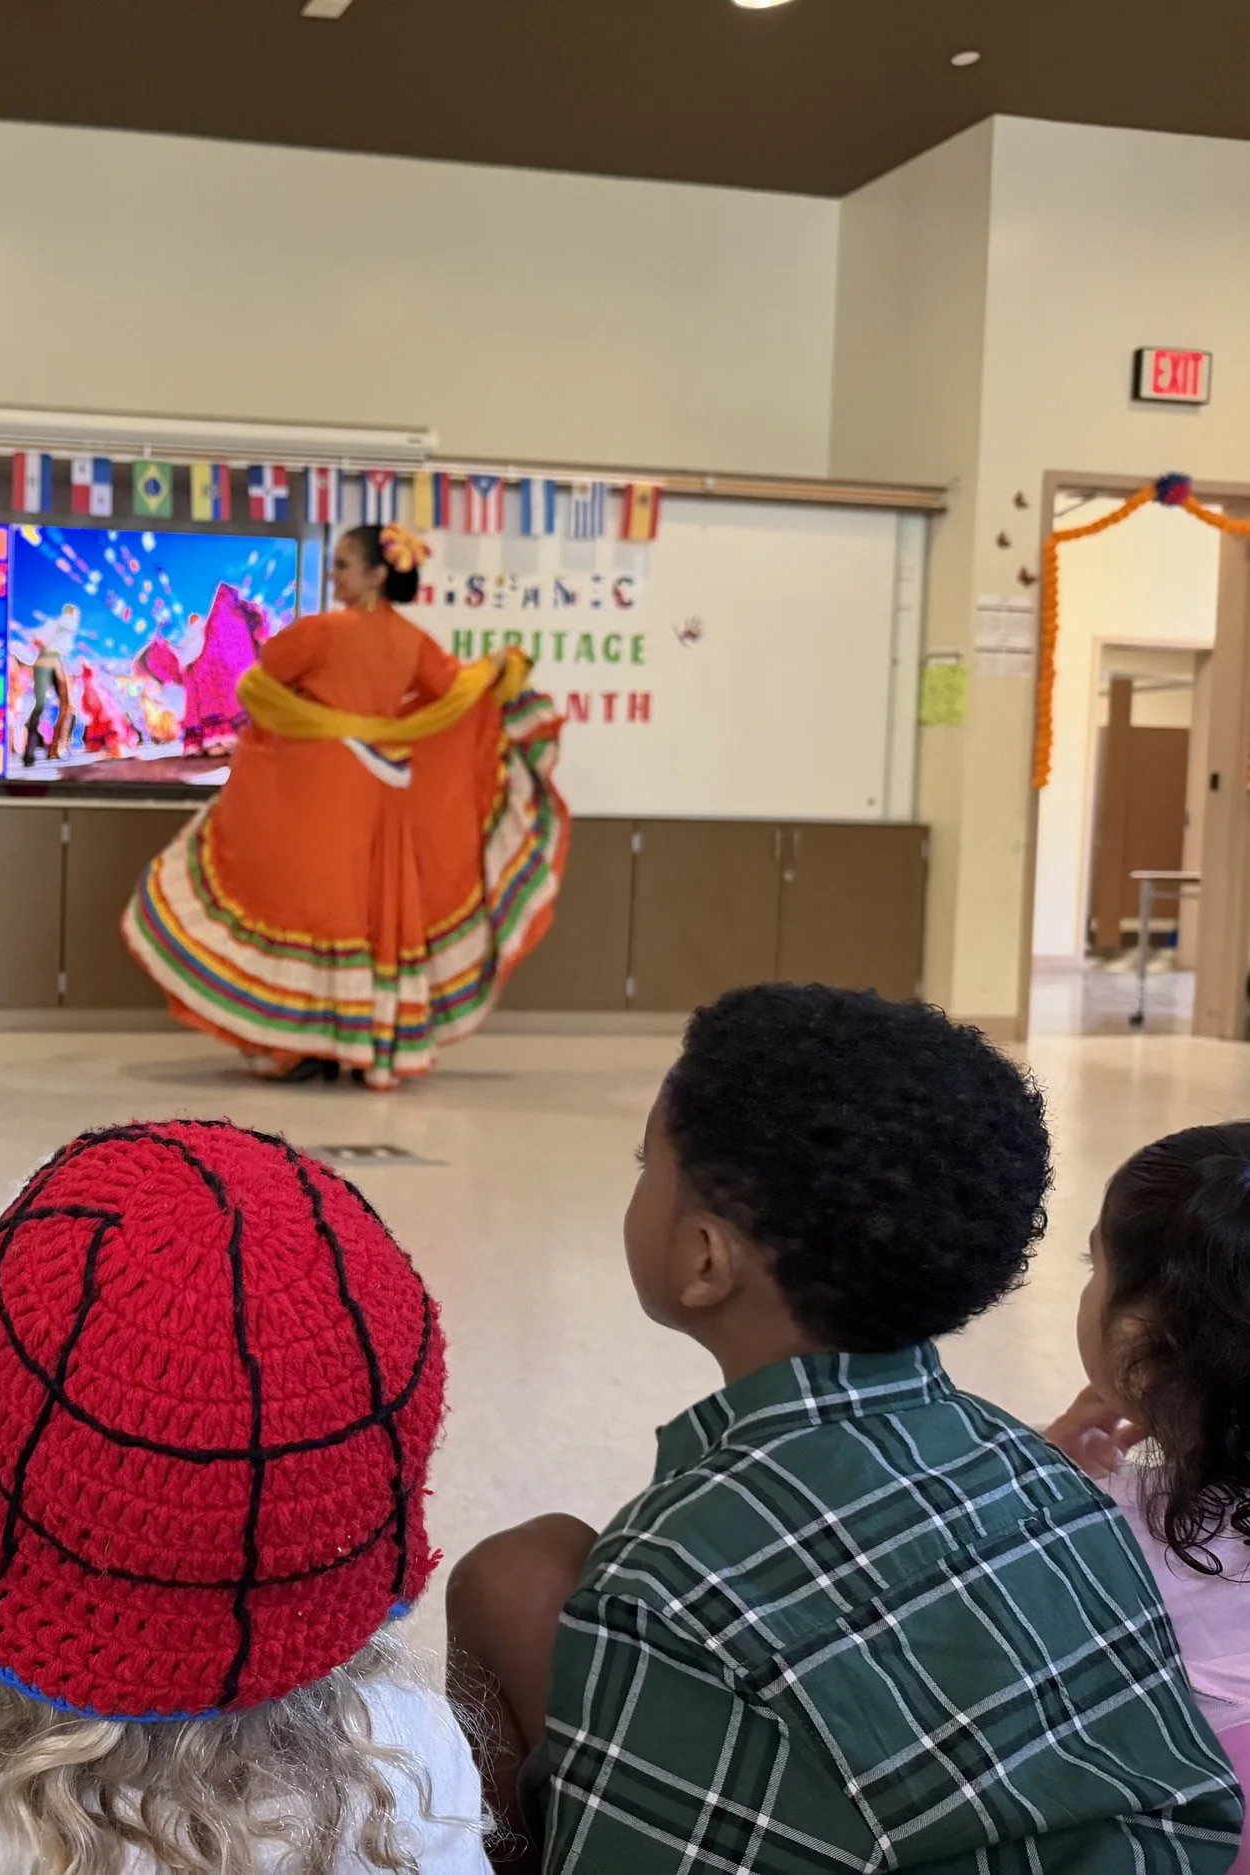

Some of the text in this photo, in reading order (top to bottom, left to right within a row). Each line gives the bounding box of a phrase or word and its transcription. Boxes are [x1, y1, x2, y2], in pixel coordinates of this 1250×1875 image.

[1153, 350, 1203, 396] EXIT
[452, 629, 646, 665] HERITAGE
[564, 690, 652, 723] NTH
